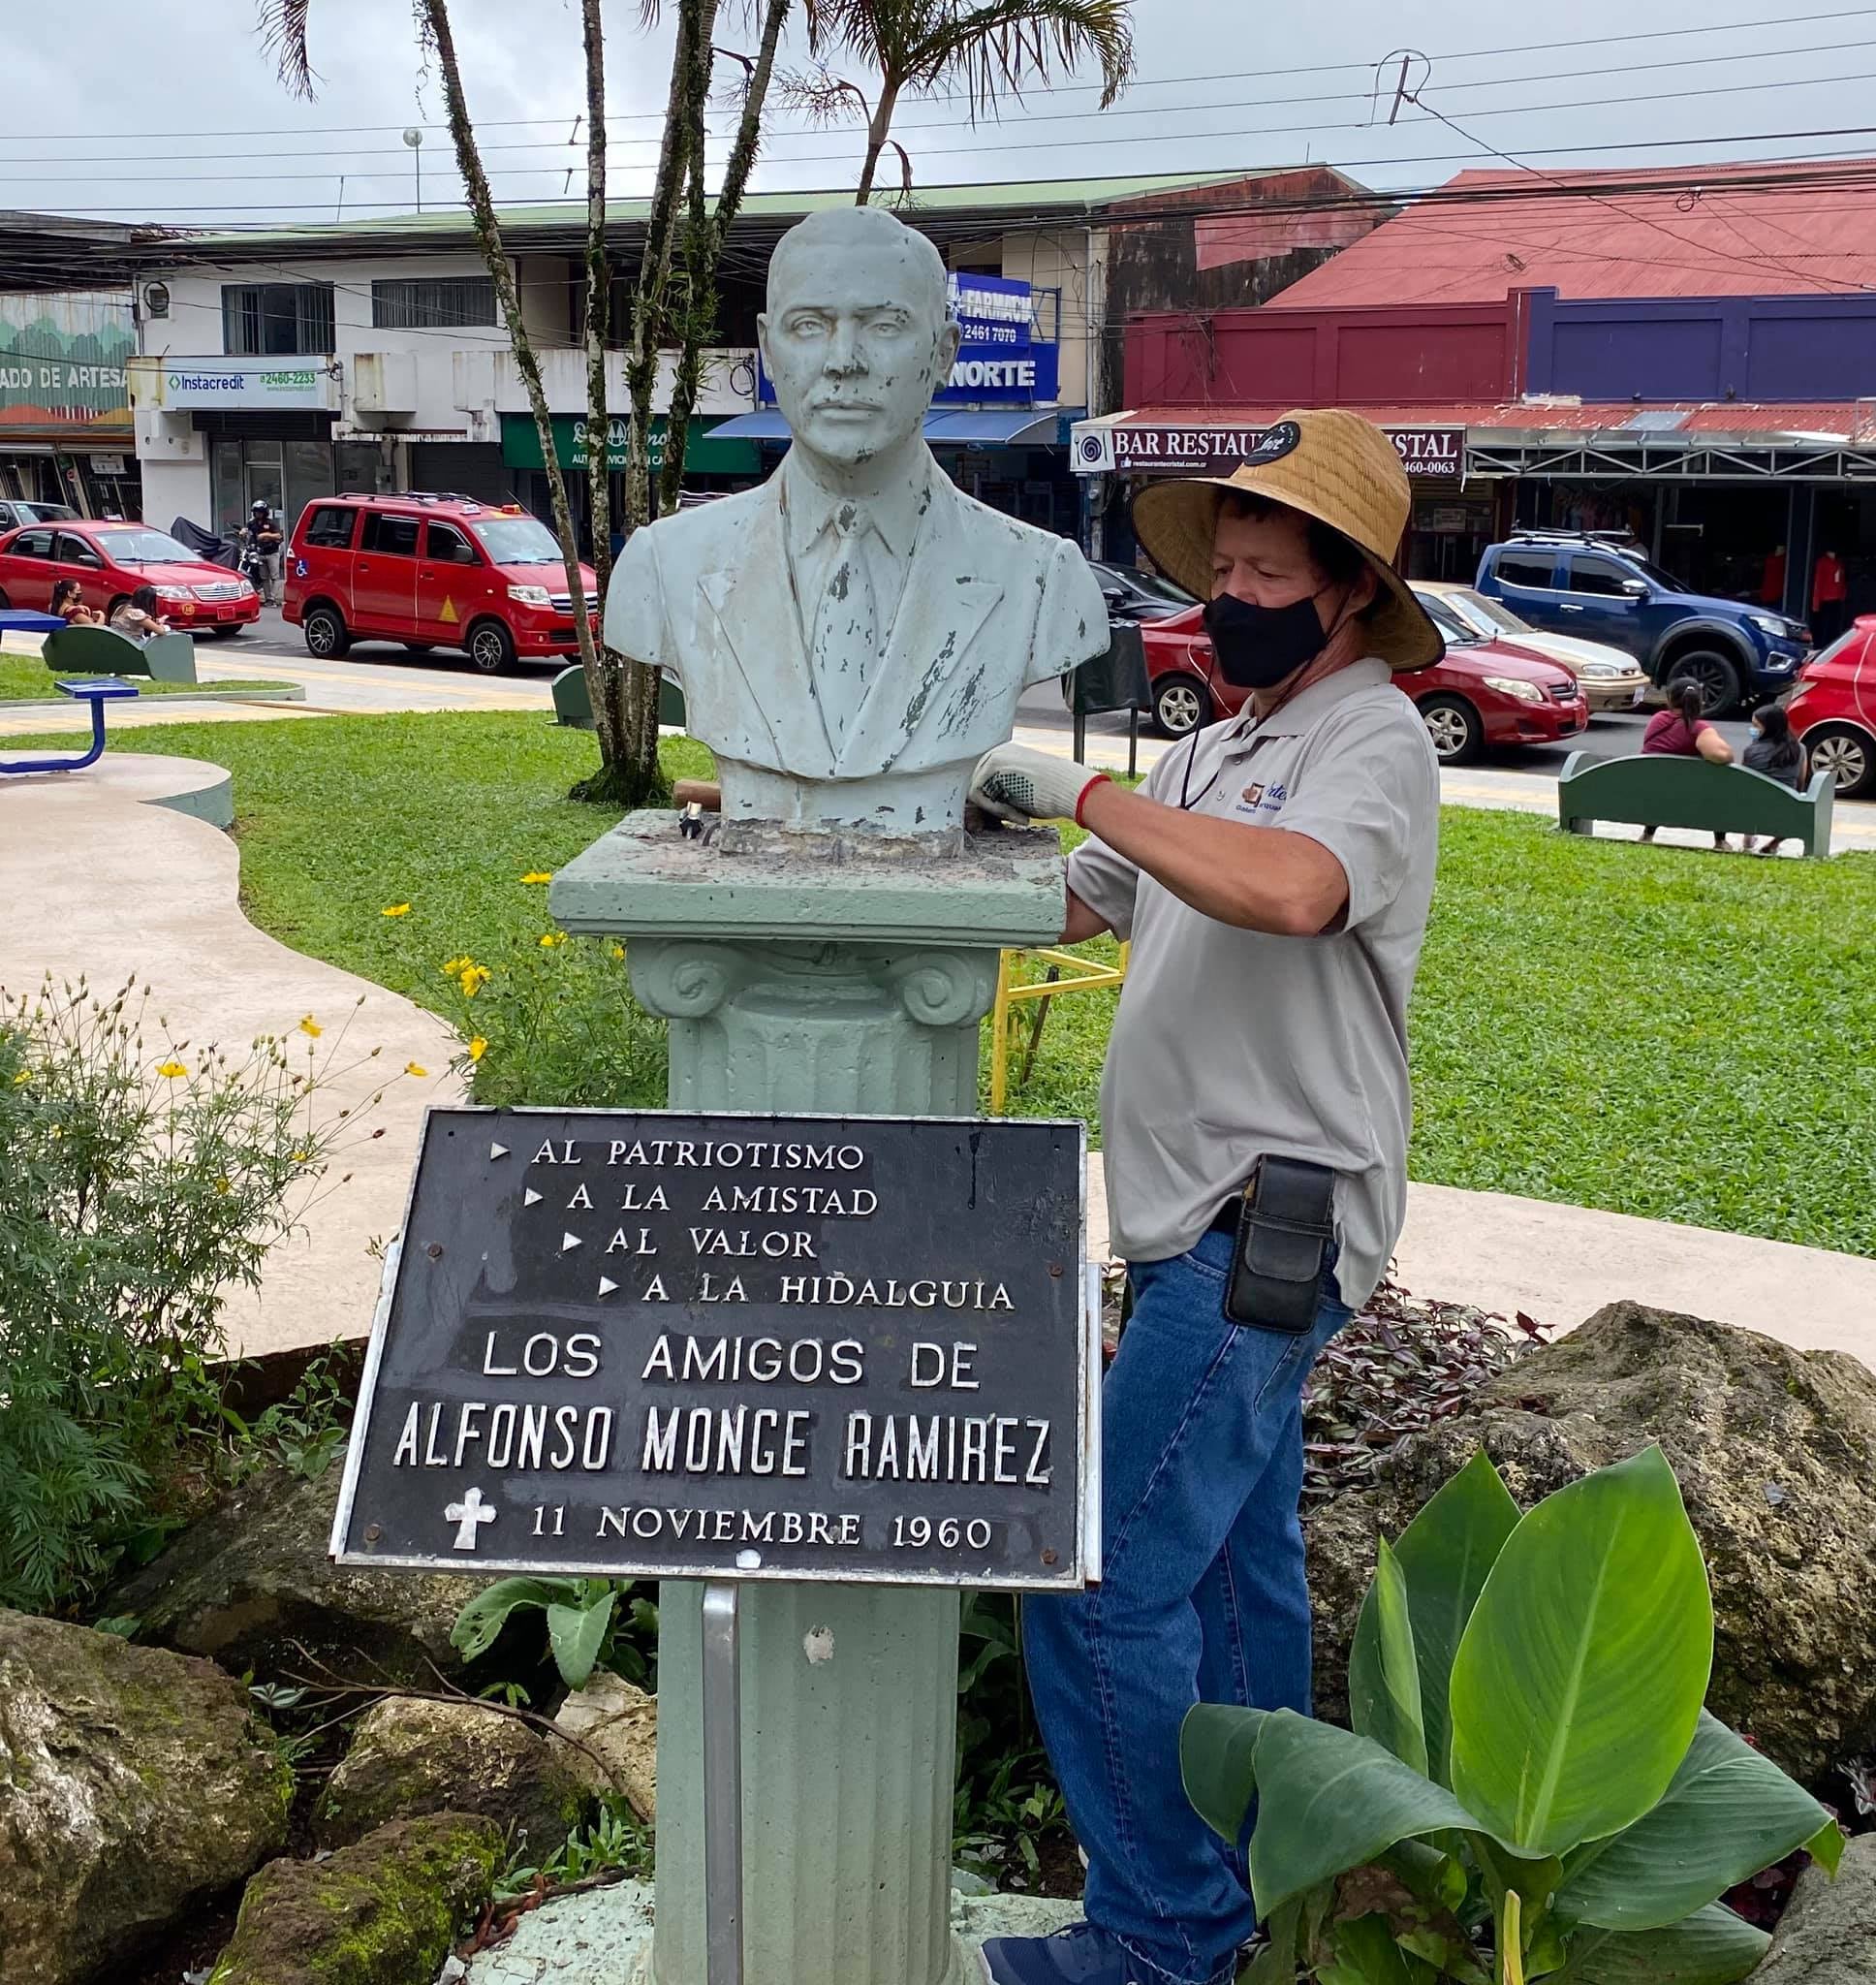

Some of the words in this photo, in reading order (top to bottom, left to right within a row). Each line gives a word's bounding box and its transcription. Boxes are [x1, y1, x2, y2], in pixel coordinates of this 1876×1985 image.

[964, 324, 989, 341] 2461
[991, 327, 1016, 343] 7070
[41, 367, 61, 389] DE
[181, 374, 244, 390] Instacredit
[949, 361, 1035, 387] NORTE
[1114, 432, 1161, 455] BAR
[1165, 432, 1265, 457] RESTAU
[531, 1138, 582, 1165] AL
[607, 1139, 864, 1170] PATRIOTISMO
[566, 1182, 595, 1211] A
[620, 1183, 671, 1212] LA
[701, 1185, 878, 1216] AMISTAD
[605, 1227, 659, 1255] AL
[688, 1227, 818, 1258] VALOR
[641, 1274, 671, 1303] A
[700, 1274, 749, 1304] LA
[778, 1275, 1016, 1309] HIDALGUIA
[483, 1330, 602, 1378] LOS
[641, 1334, 865, 1385] AMIGOS
[910, 1340, 982, 1389] DE
[392, 1401, 614, 1470] ALFONSO
[641, 1405, 810, 1476] MONGE
[845, 1411, 1052, 1486] RAMIREZ
[531, 1504, 567, 1537] 11
[596, 1506, 861, 1546] NOVIEMBRE
[892, 1514, 992, 1550] 1960
